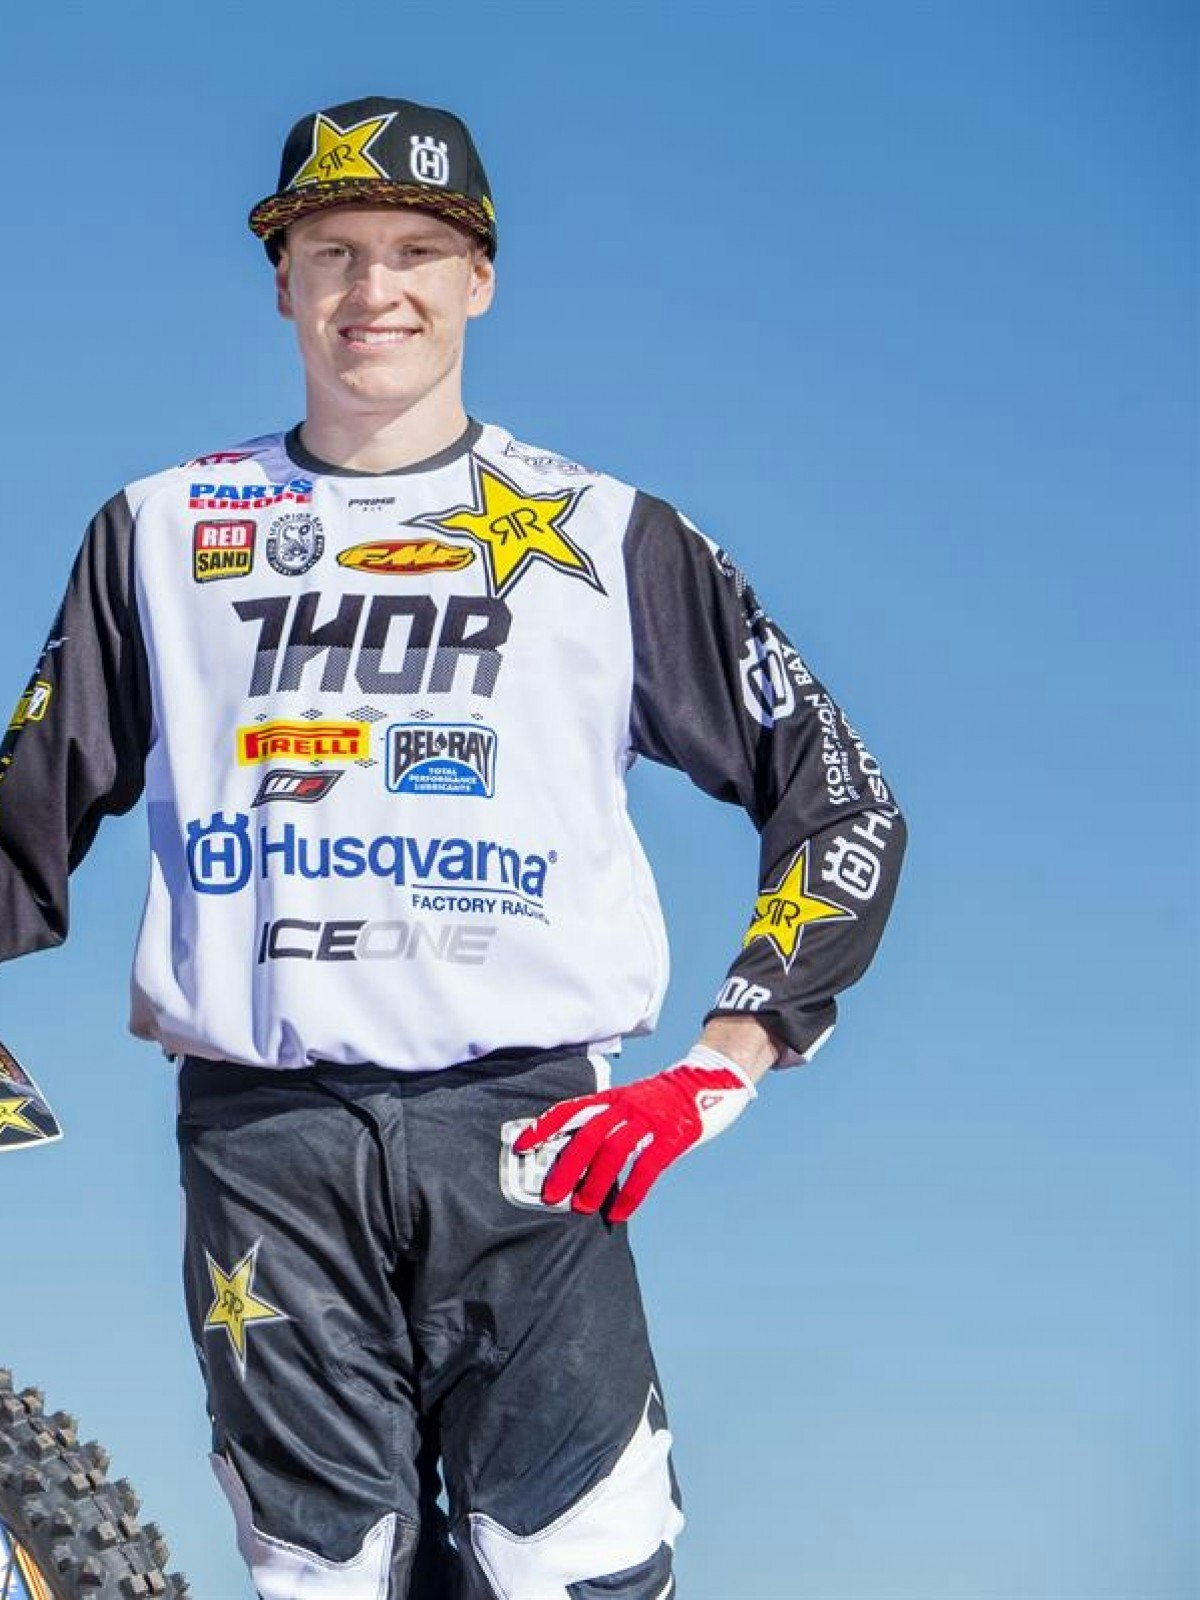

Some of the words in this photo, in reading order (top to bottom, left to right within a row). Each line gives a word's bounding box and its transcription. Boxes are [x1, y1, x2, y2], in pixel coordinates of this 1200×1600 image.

[189, 478, 313, 501] PARTS
[201, 526, 247, 547] RED
[199, 551, 248, 572] SAND
[231, 591, 513, 698] THOR
[245, 726, 360, 760] PIRELLI
[261, 823, 548, 898] Husqvarna
[411, 893, 498, 914] FACTORY
